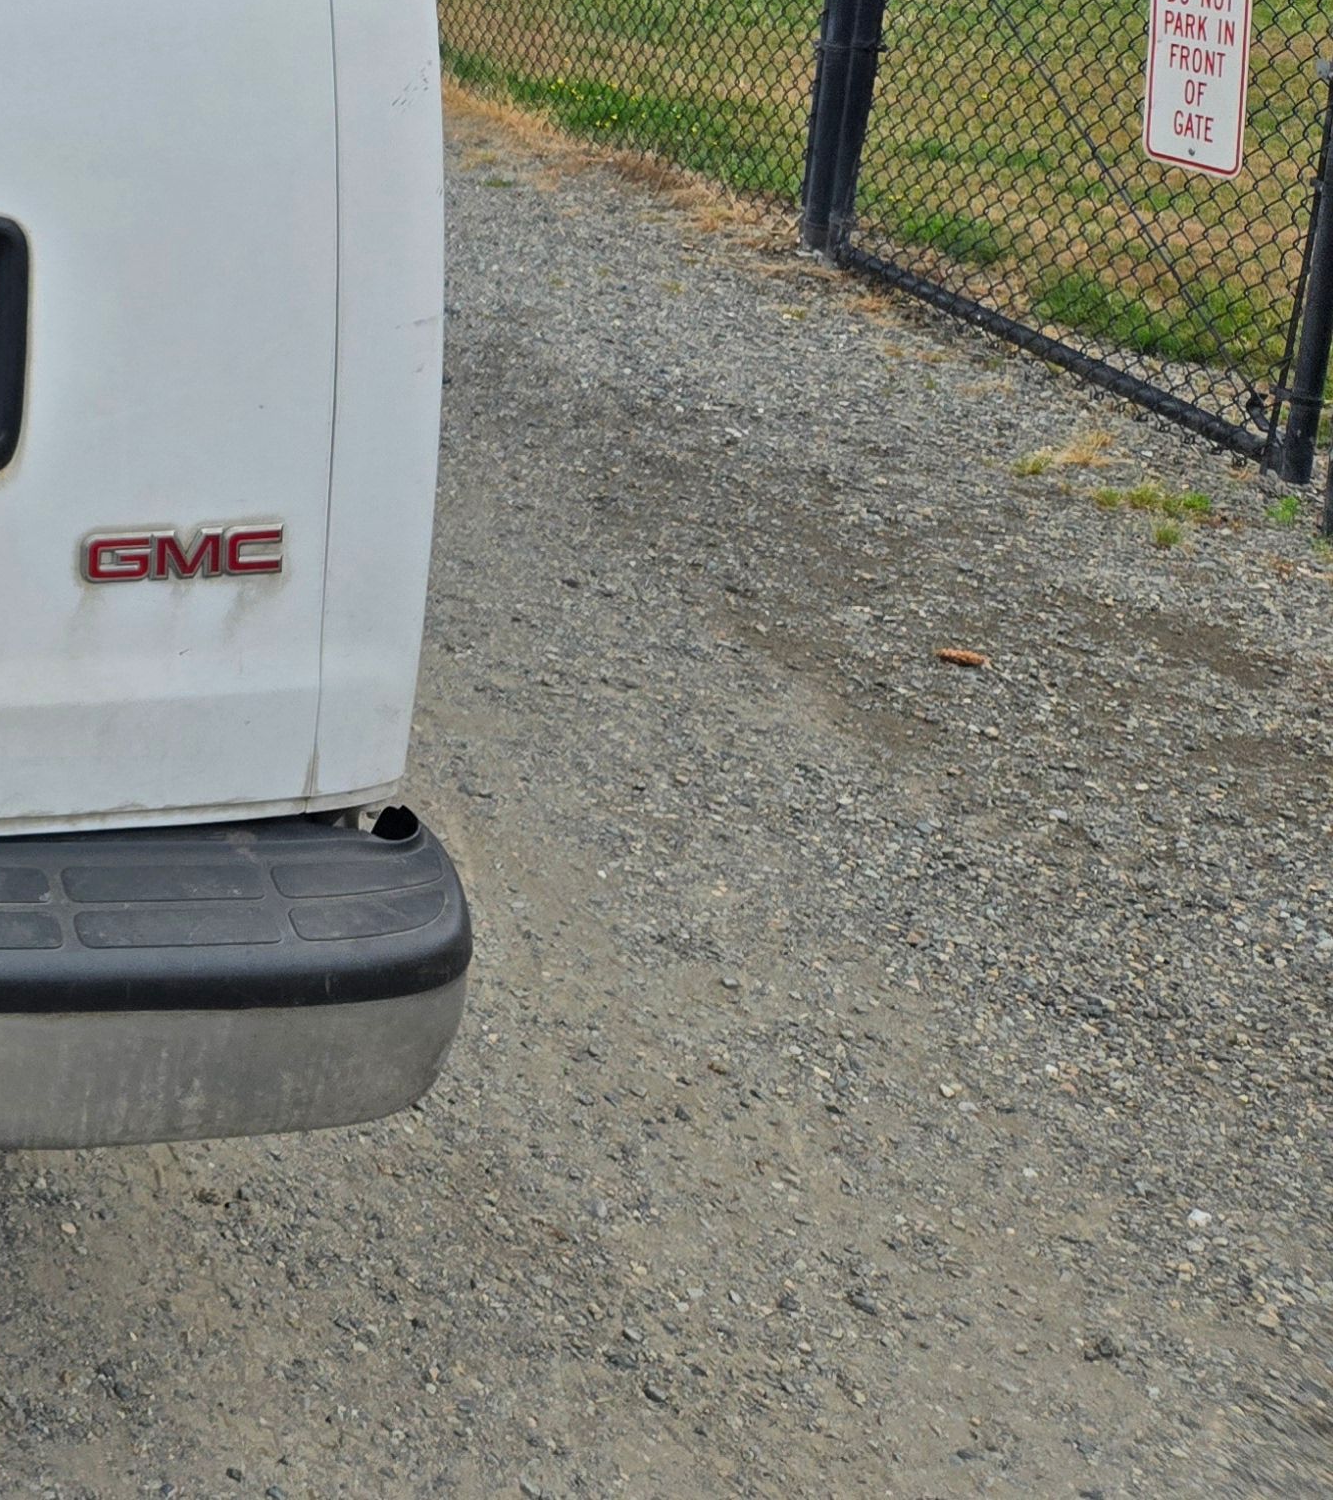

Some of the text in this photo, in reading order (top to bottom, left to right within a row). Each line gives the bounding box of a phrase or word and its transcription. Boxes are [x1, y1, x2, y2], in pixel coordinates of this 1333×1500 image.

[1164, 10, 1235, 46] PARK IN
[1169, 43, 1226, 78] FRONT
[1185, 79, 1207, 107] OF
[1173, 110, 1214, 143] GATE
[81, 523, 284, 583] GMC
